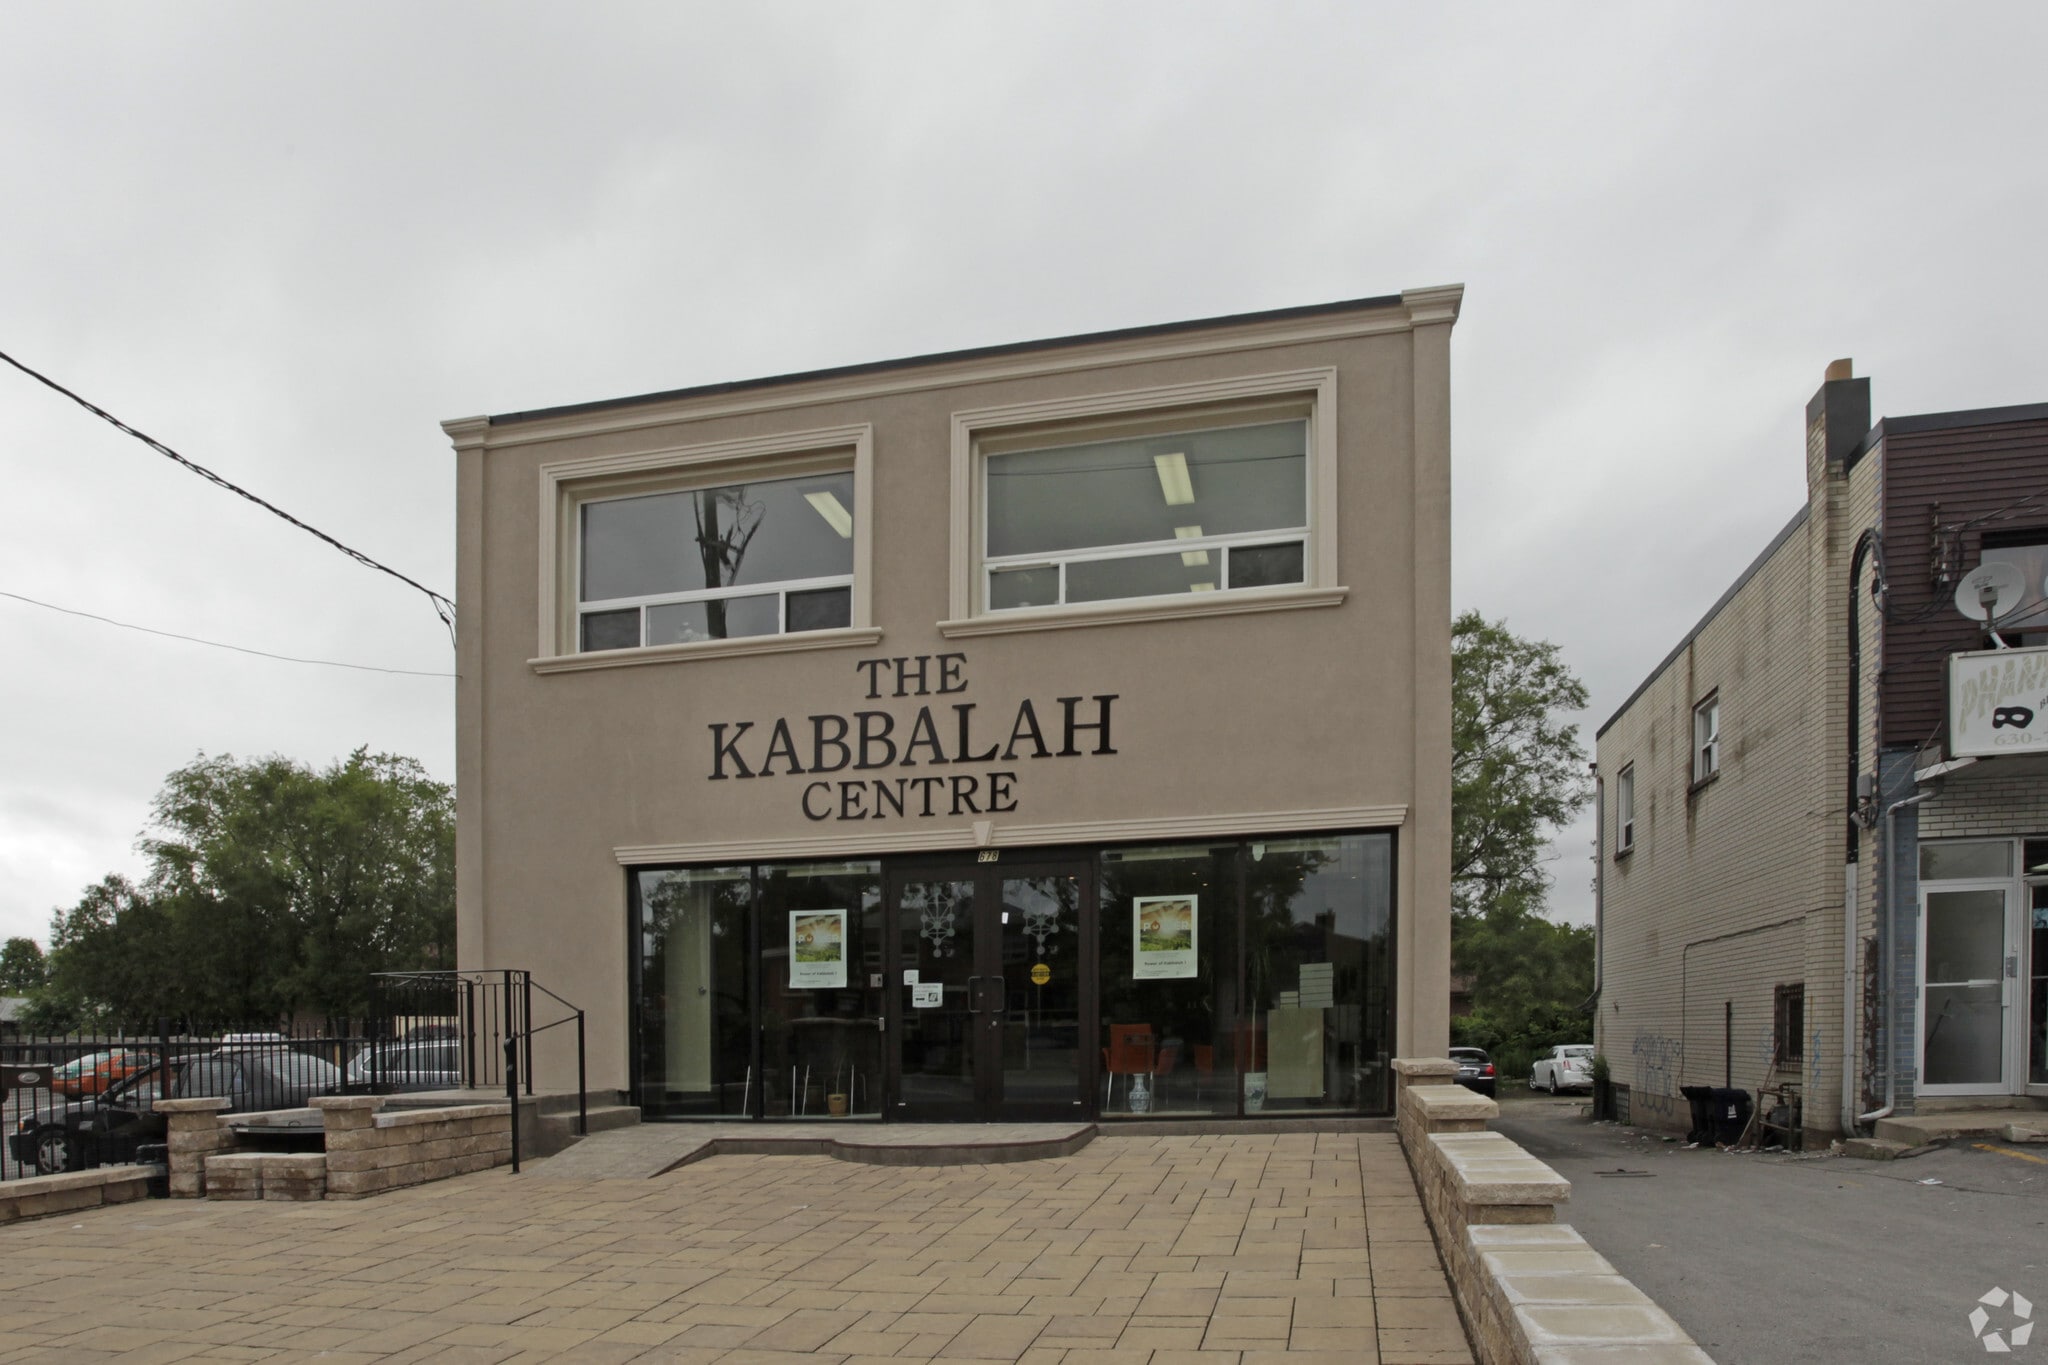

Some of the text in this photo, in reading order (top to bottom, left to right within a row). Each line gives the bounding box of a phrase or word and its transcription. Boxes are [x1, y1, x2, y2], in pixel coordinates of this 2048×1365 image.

[856, 652, 969, 699] THE
[707, 694, 1120, 780] KABBALAH
[1994, 731, 2048, 747] 630-
[802, 771, 1019, 821] CENTRE
[979, 850, 998, 862] 678
